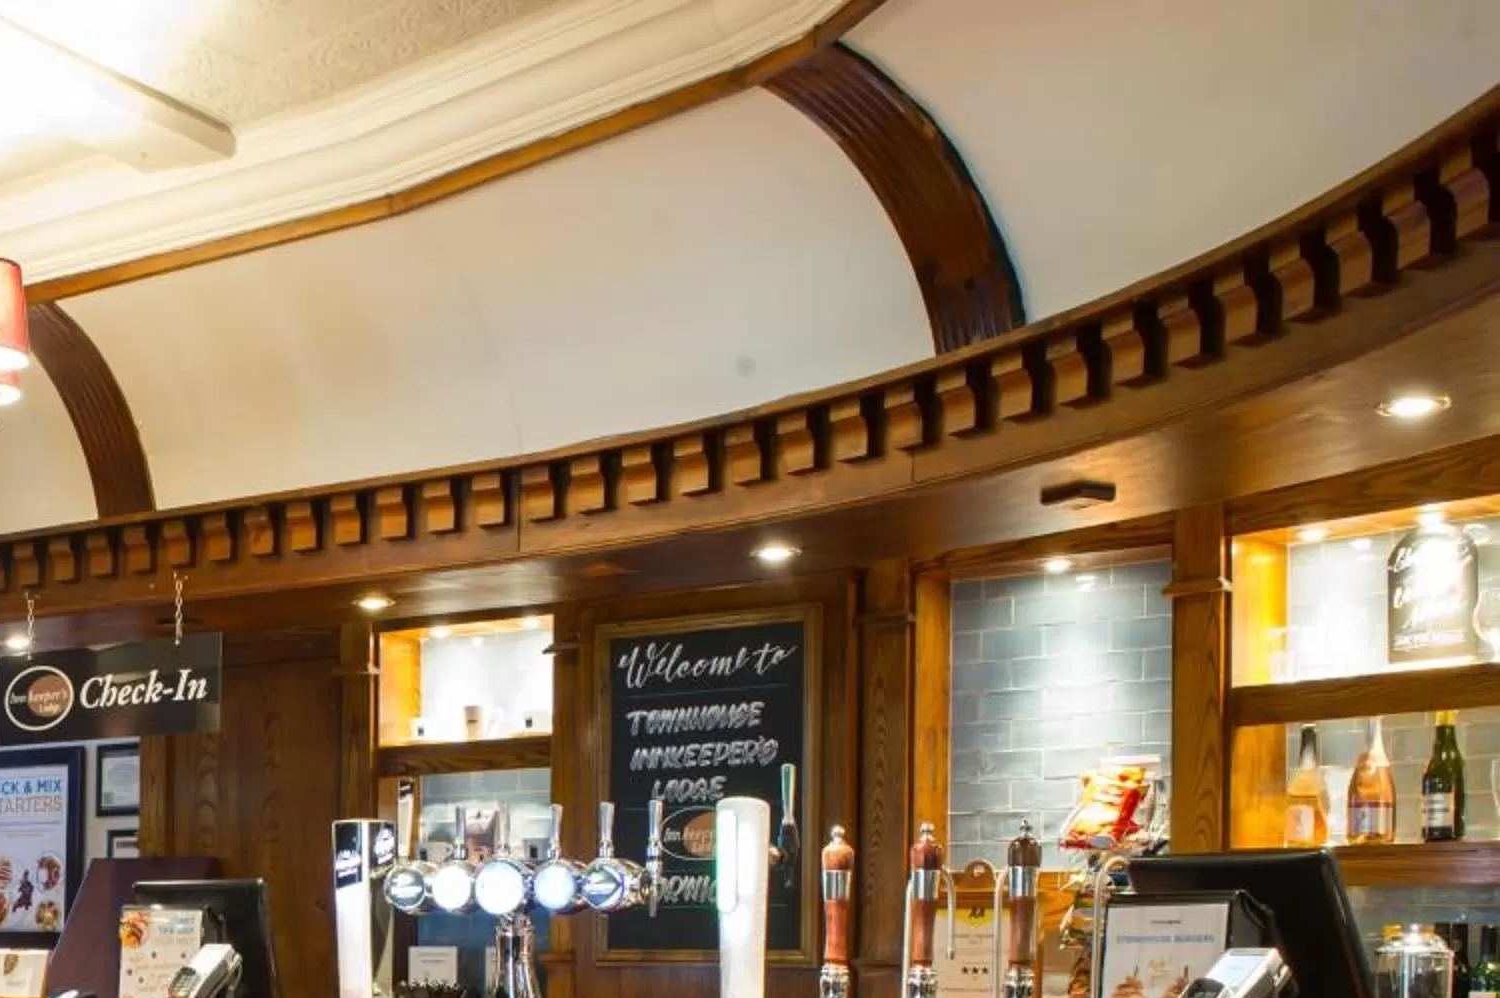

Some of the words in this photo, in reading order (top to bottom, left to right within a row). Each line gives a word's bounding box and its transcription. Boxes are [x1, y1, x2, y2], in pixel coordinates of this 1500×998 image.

[618, 641, 751, 689] Welcome
[753, 642, 798, 676] to
[80, 669, 207, 710] Check-In
[629, 735, 779, 771] INNKEEPER'S
[23, 779, 33, 795] &
[37, 778, 62, 793] MIX
[651, 775, 728, 804] LODGE
